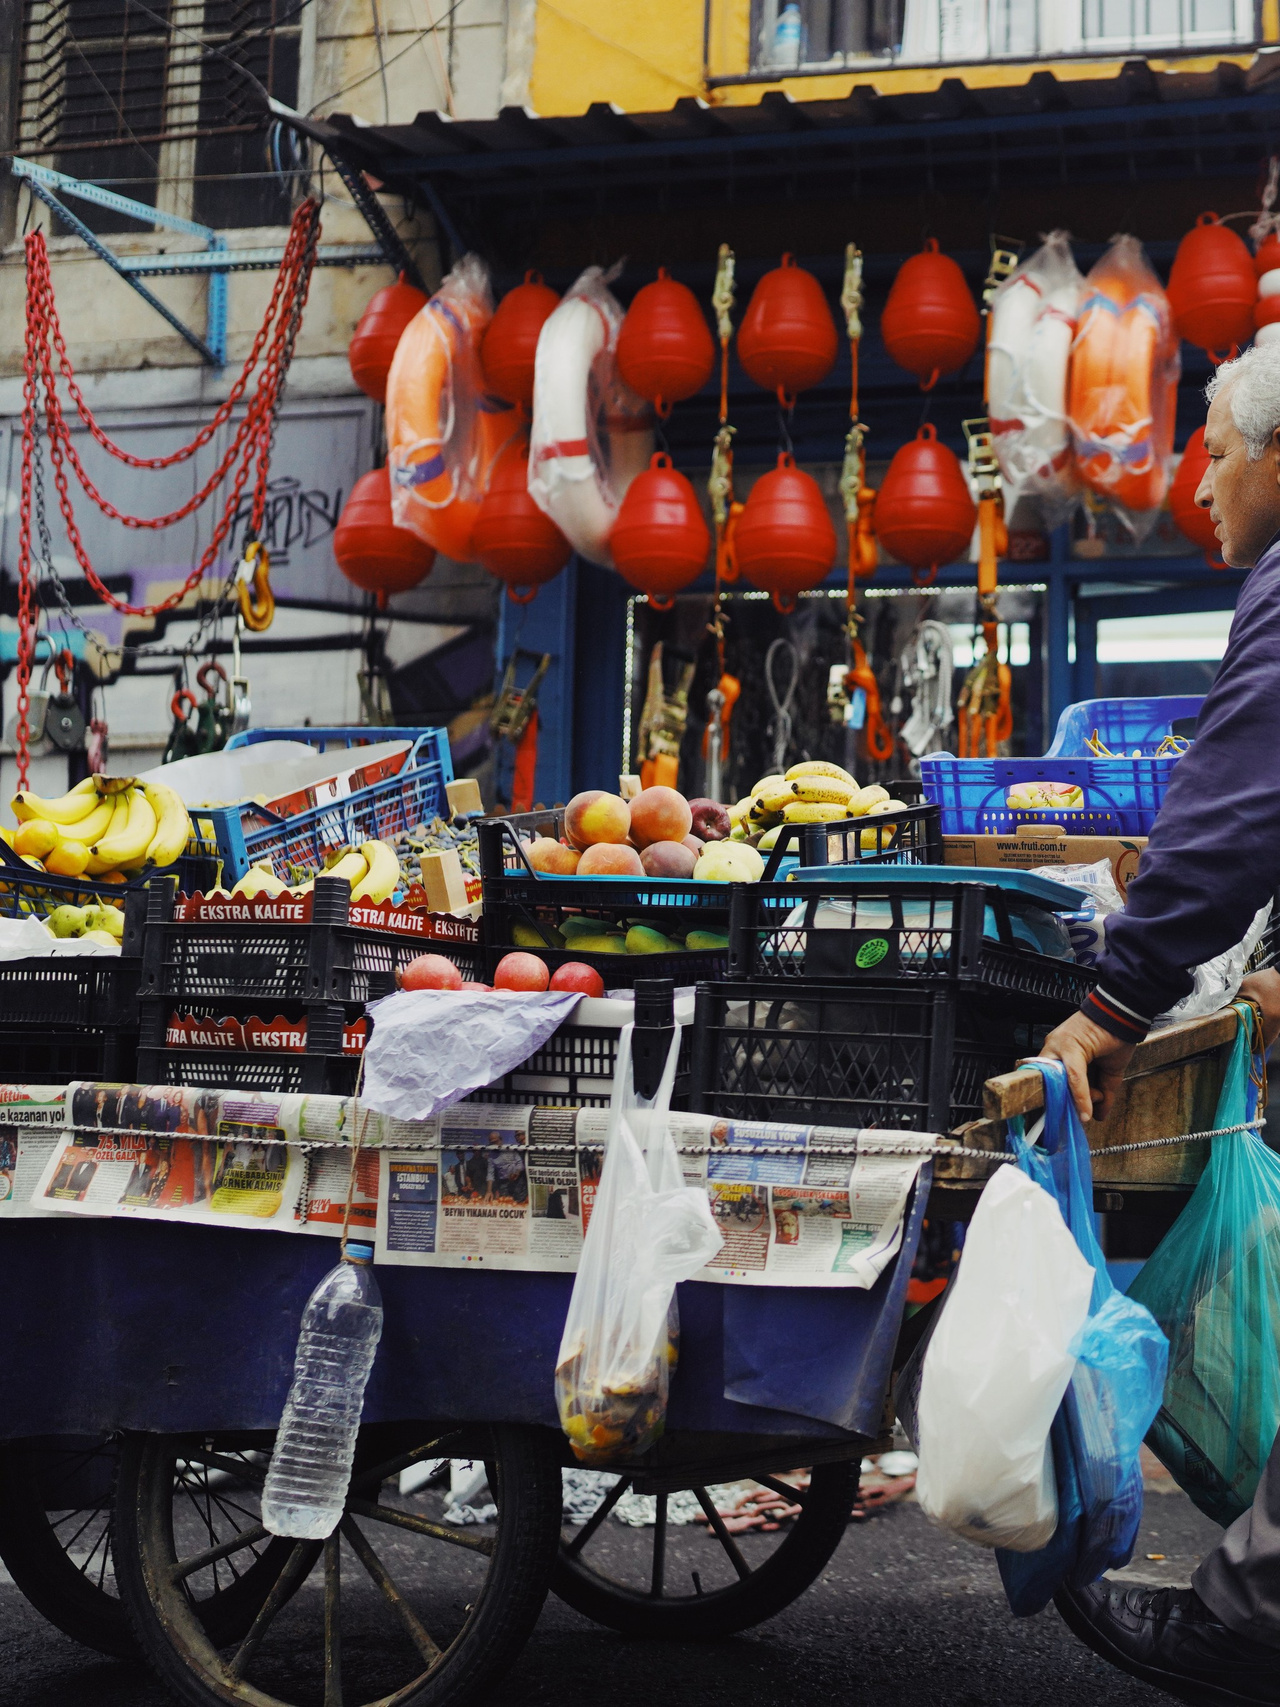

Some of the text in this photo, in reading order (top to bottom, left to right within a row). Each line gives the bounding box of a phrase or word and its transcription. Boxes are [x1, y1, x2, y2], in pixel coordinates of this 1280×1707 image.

[996, 841, 1067, 852] www.fruti.com.tr
[200, 905, 251, 920] EKSTRA
[7, 1108, 48, 1122] kazanan
[734, 1128, 778, 1140] SUSUZLUK
[97, 1134, 147, 1151] 75. YILA
[115, 1151, 137, 1161] GALA
[561, 1169, 577, 1178] daha
[556, 1177, 577, 1187] OLDU
[582, 1184, 594, 1194] 20
[466, 1208, 497, 1219] YIKANAN
